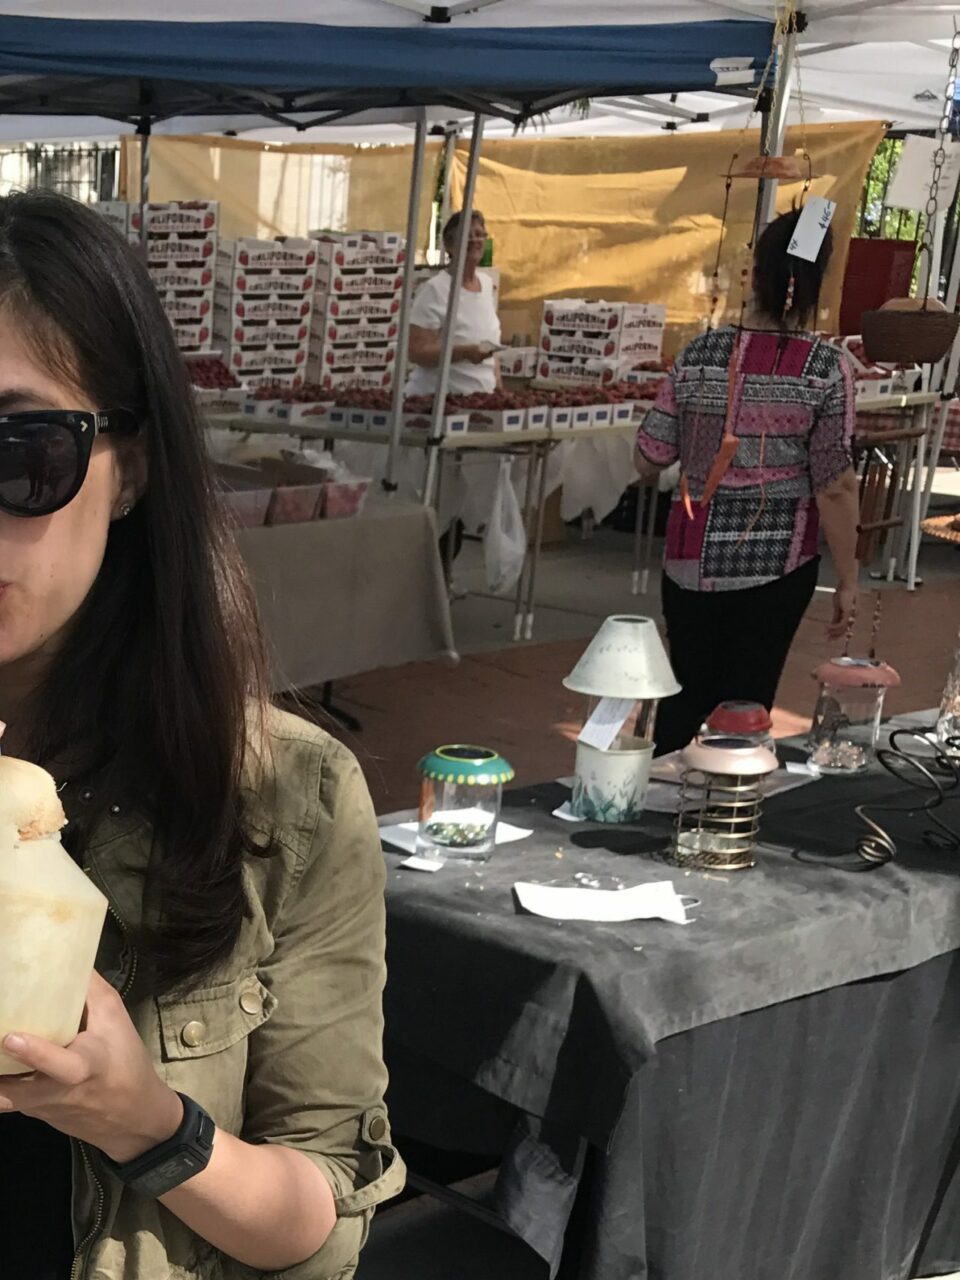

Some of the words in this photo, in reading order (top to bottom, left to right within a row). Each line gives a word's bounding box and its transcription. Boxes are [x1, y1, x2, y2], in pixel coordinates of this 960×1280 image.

[150, 213, 201, 224] ALIFORNIA
[150, 242, 200, 253] ALIFORNIA
[556, 312, 606, 324] CALIFORNIA
